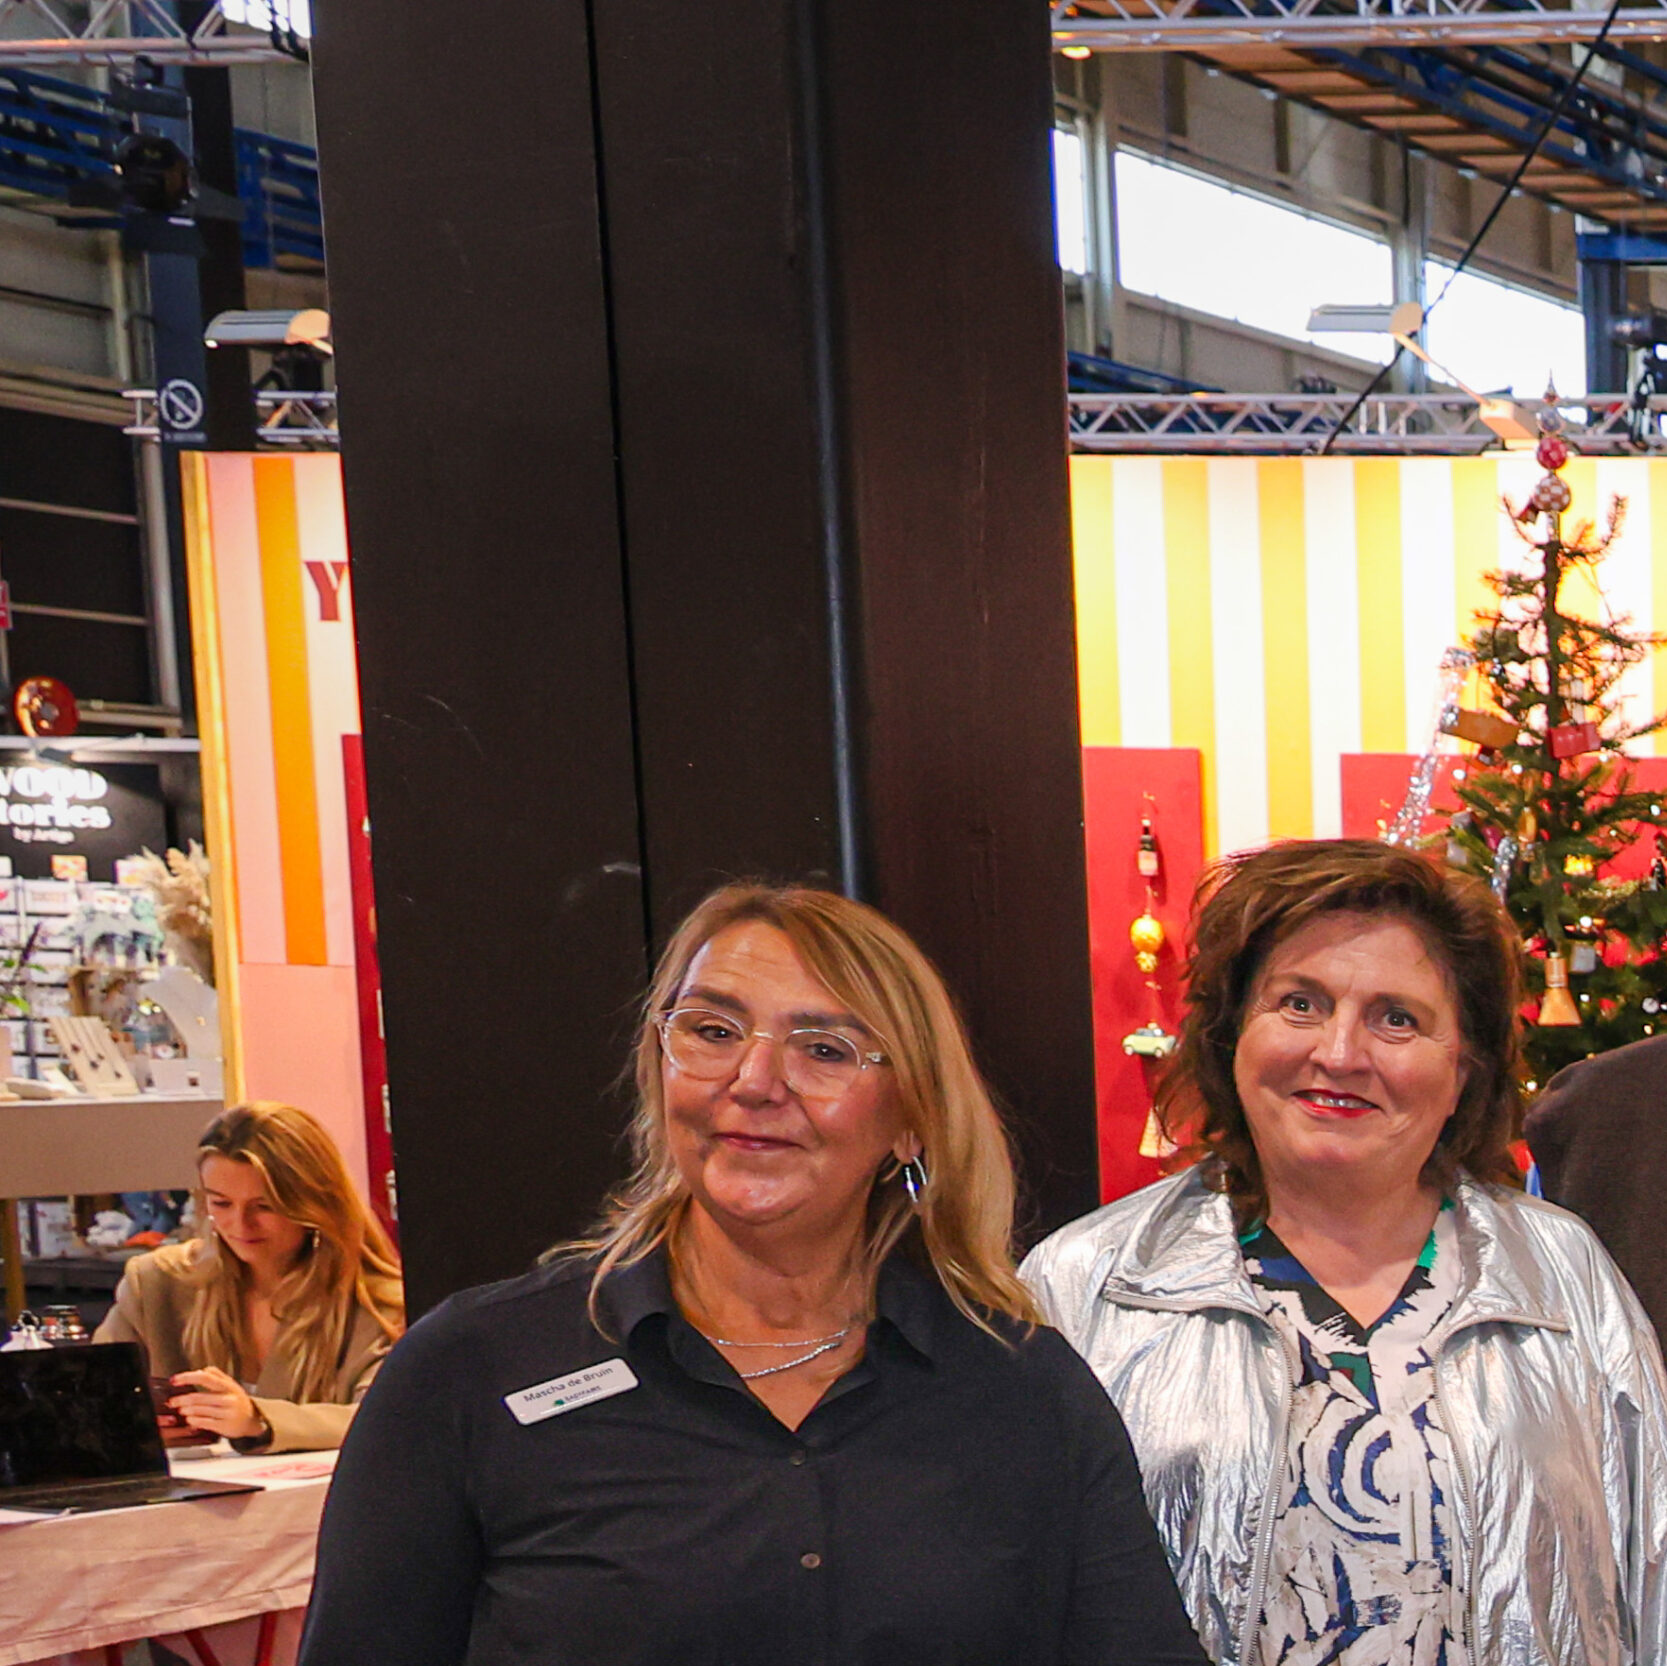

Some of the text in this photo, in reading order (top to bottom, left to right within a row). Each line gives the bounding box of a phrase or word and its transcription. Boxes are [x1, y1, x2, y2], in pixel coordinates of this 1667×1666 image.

[523, 1366, 614, 1403] Mascha de Bruin
